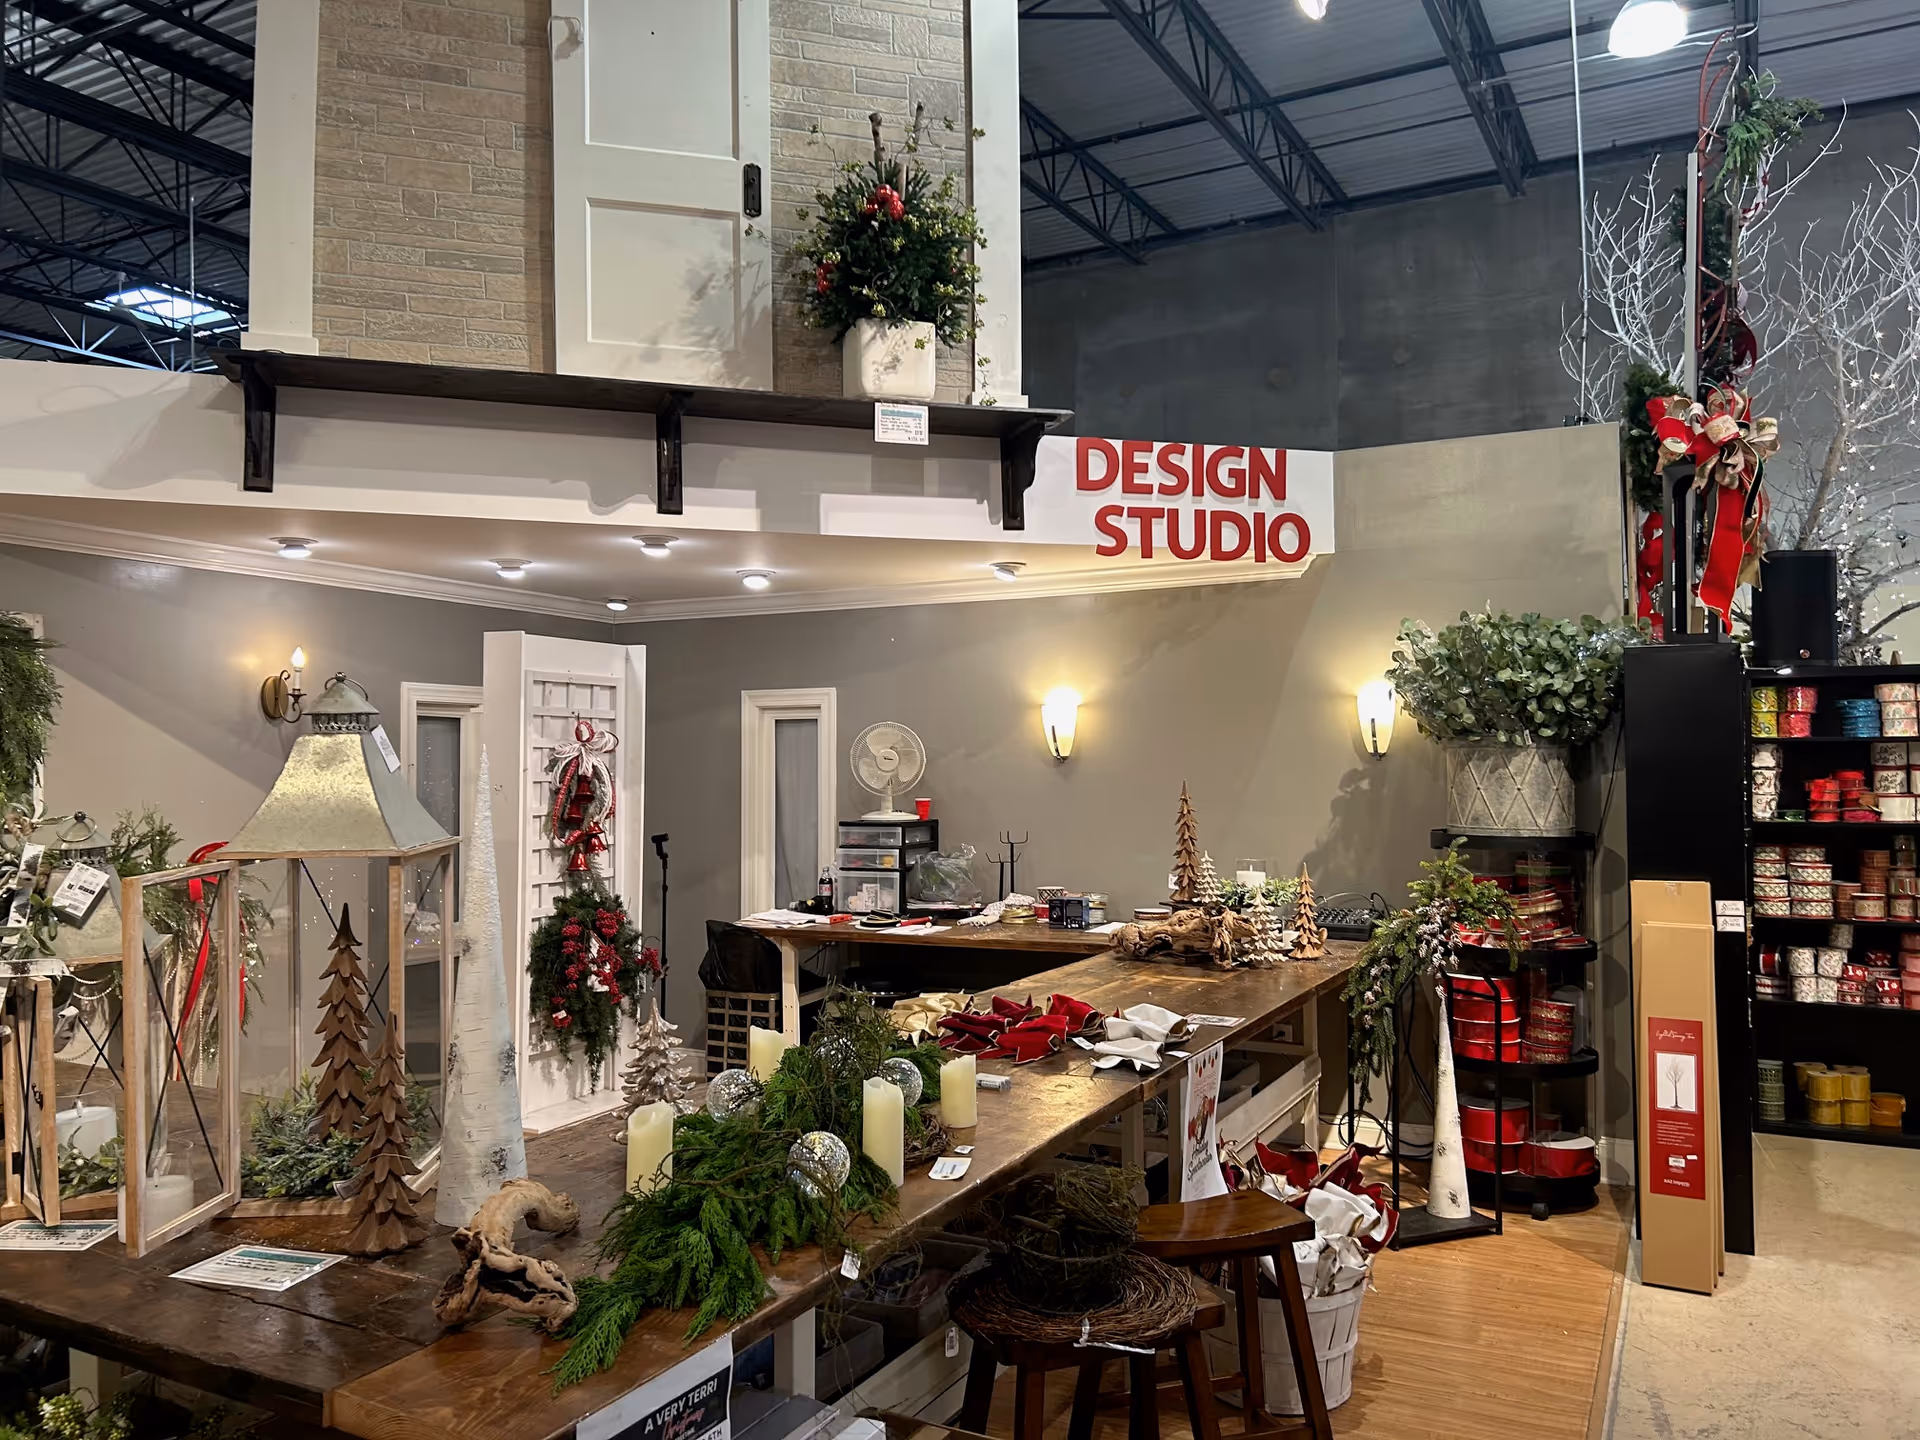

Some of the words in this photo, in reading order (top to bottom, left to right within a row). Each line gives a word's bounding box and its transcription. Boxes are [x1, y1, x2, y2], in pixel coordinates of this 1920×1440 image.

[1076, 438, 1287, 500] DESIGN
[1095, 504, 1311, 563] STUDIO
[644, 1418, 654, 1435] A
[656, 1397, 686, 1426] VERY
[688, 1378, 718, 1406] TERRI
